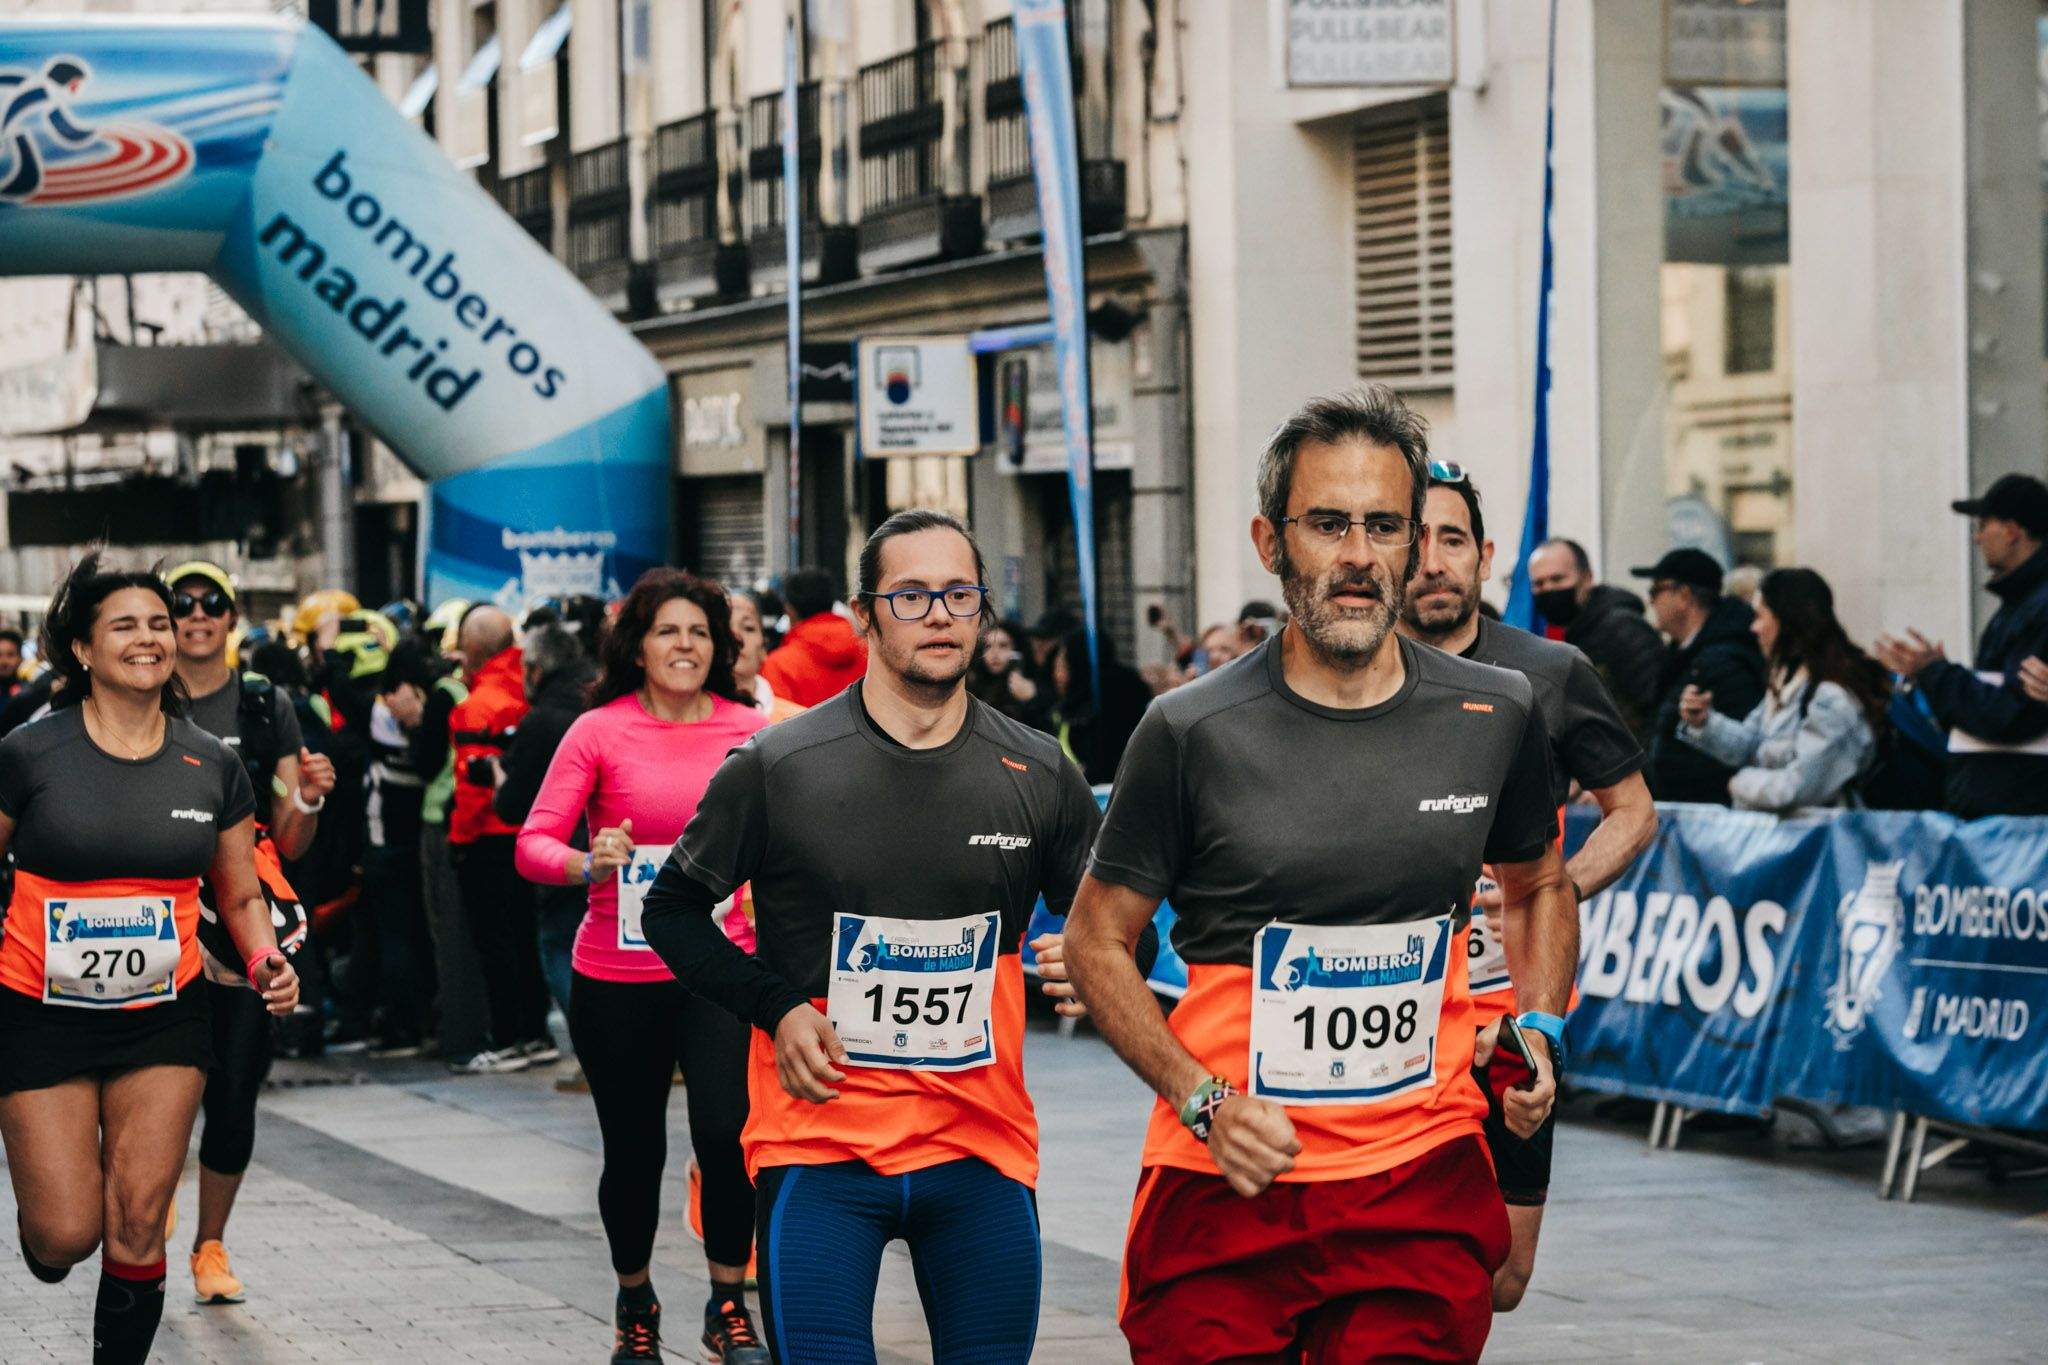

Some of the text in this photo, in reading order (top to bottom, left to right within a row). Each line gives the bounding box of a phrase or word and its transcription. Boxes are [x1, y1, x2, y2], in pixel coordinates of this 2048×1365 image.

[313, 150, 566, 399] bomberos
[259, 212, 483, 412] madrid
[80, 948, 146, 979] 270
[890, 942, 973, 958] BOMBEROS
[924, 954, 973, 971] de MADRID
[1322, 950, 1421, 972] BOMBEROS
[1362, 965, 1420, 985] de MADRID
[864, 983, 974, 1026] 1557
[1932, 993, 2030, 1041] MADRID
[1293, 999, 1418, 1051] 1098
